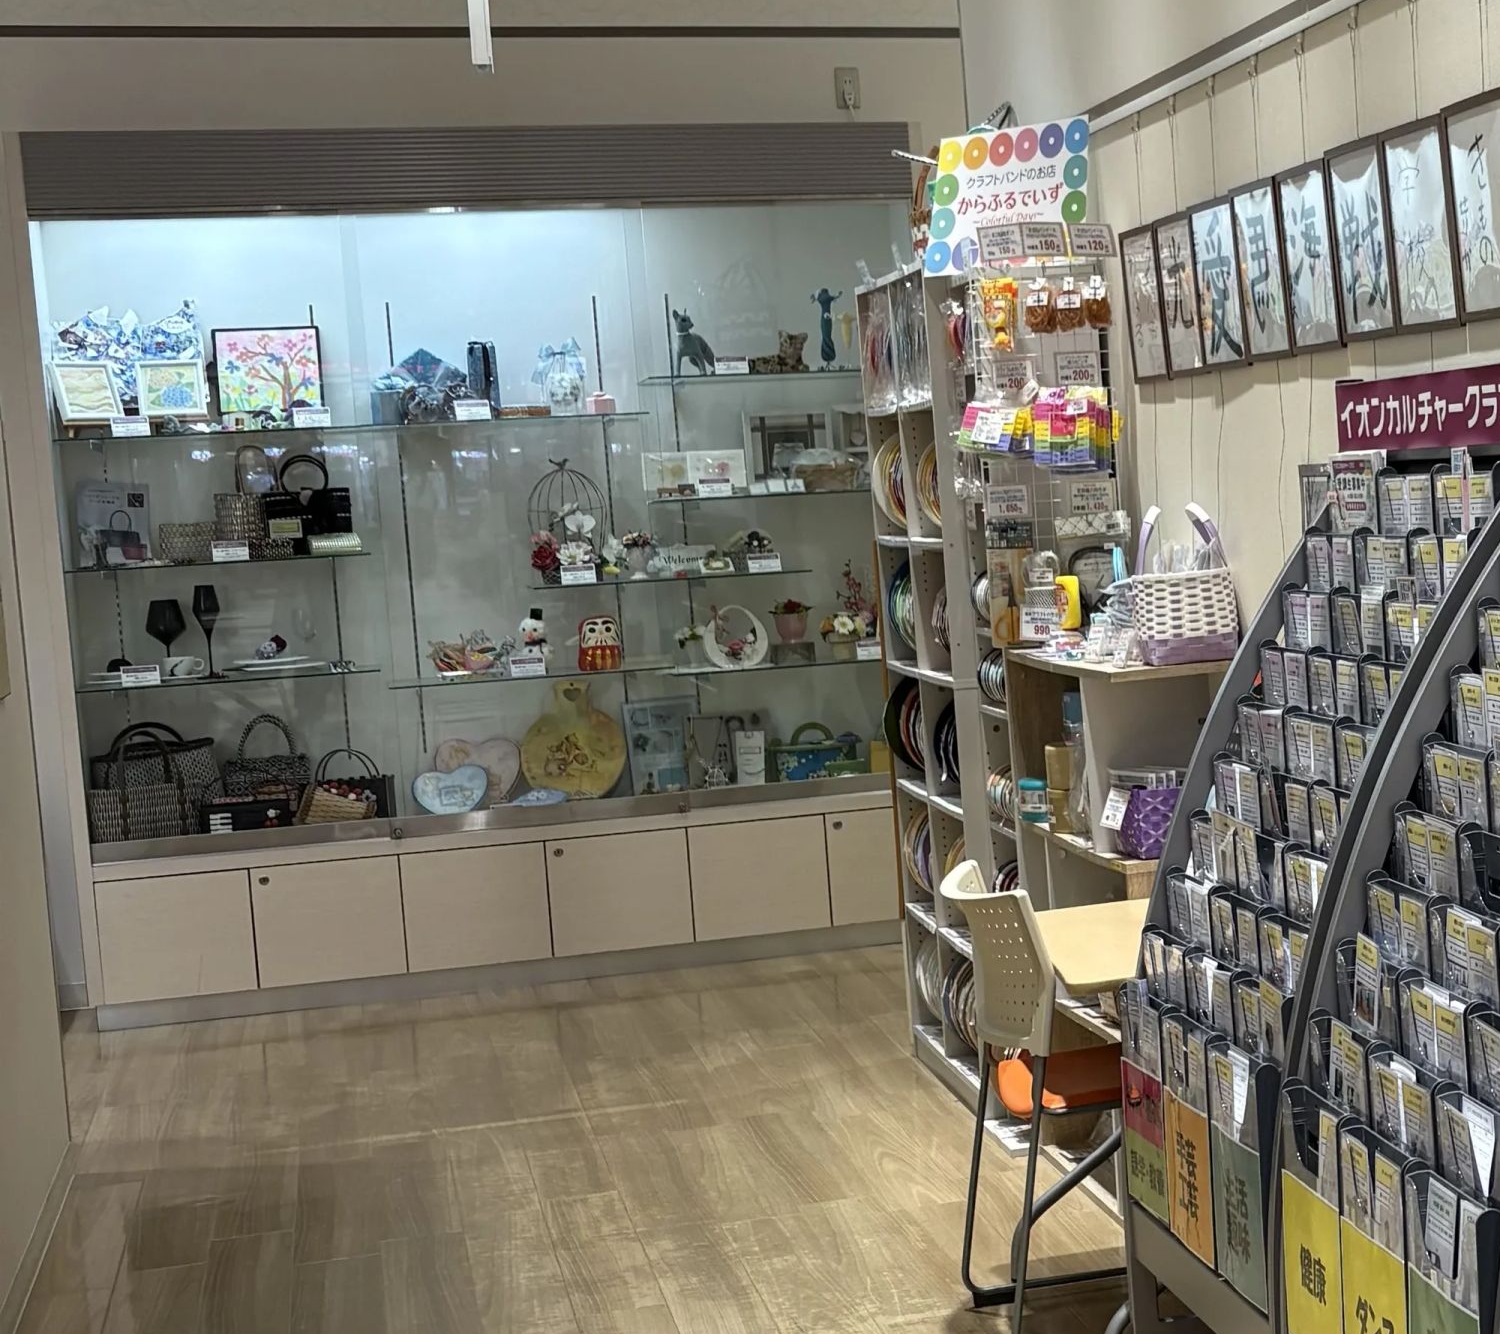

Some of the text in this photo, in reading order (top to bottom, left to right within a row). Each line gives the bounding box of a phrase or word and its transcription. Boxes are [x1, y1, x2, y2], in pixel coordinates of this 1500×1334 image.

[966, 165, 1056, 189] クラフトバンドのお店
[957, 182, 1063, 215] からふるでいず
[1299, 1243, 1328, 1307] 健康
